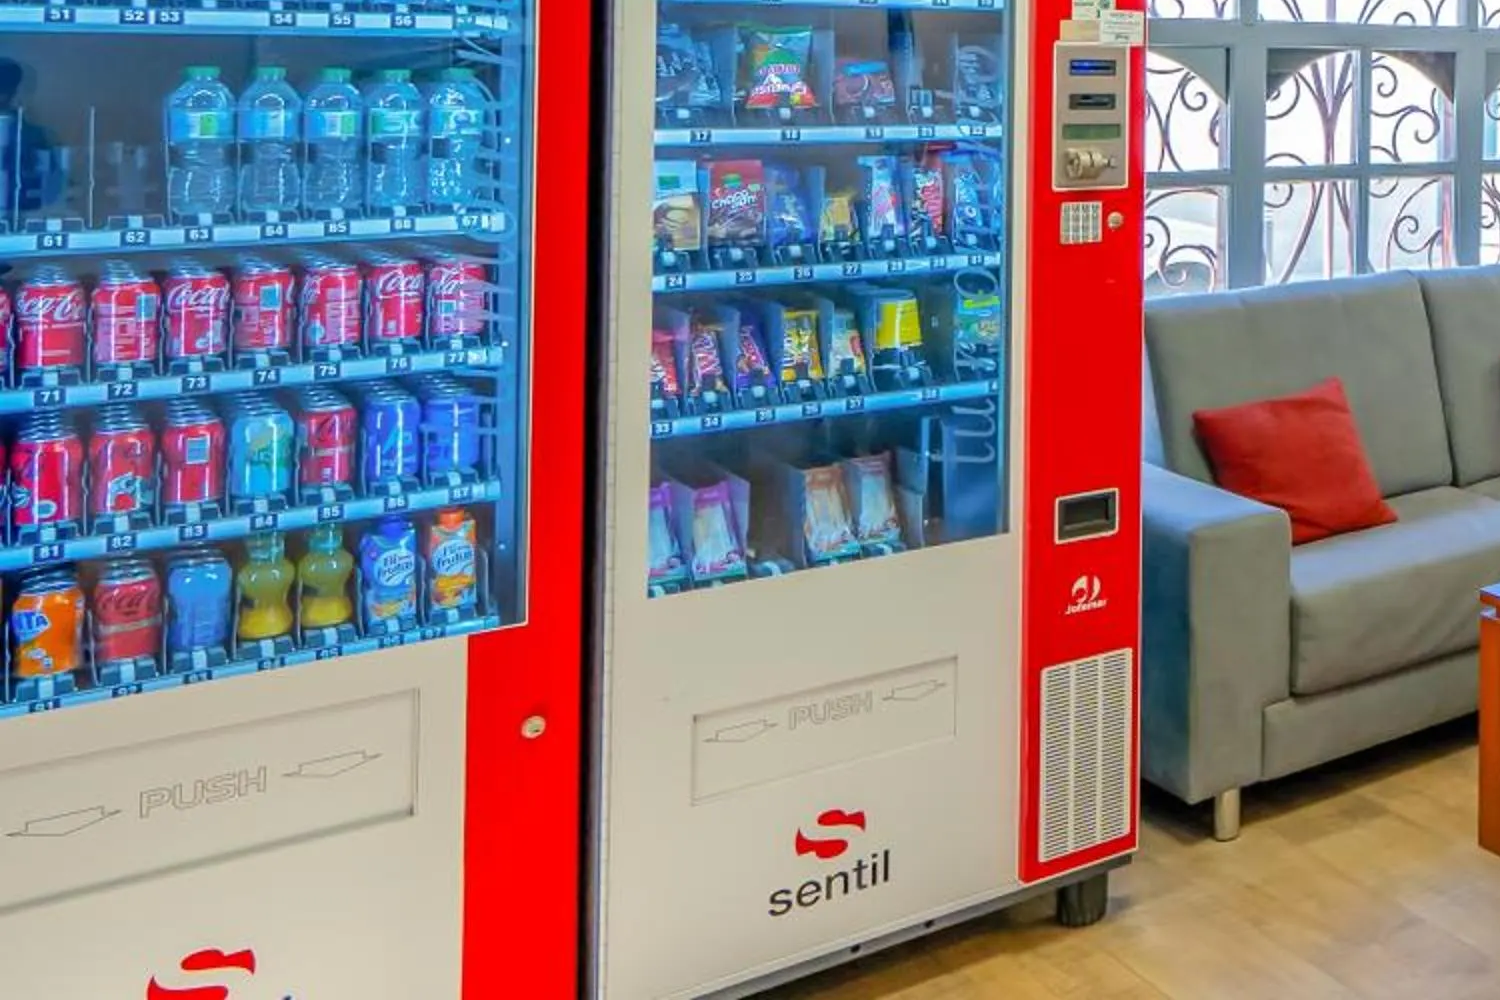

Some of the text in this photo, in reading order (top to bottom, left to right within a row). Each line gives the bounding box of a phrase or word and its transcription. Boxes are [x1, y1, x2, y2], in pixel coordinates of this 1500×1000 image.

[50, 9, 71, 20] 51
[124, 9, 145, 21] 52
[160, 10, 180, 22] 53
[273, 13, 293, 24] 54
[333, 14, 352, 25] 55
[394, 14, 413, 26] 56
[189, 229, 209, 240] 63
[265, 225, 284, 237] 64
[43, 235, 63, 247] 61
[125, 231, 145, 244] 62
[391, 357, 408, 368] 76
[448, 352, 465, 363] 77
[257, 371, 276, 382] 74
[319, 365, 337, 376] 75
[187, 377, 207, 389] 73
[113, 384, 133, 396] 72
[40, 391, 60, 403] 71
[112, 536, 131, 548] 82
[40, 545, 59, 558] 81
[787, 691, 874, 731] PUSH
[139, 765, 267, 819] PUSH
[767, 849, 890, 917] sentil
